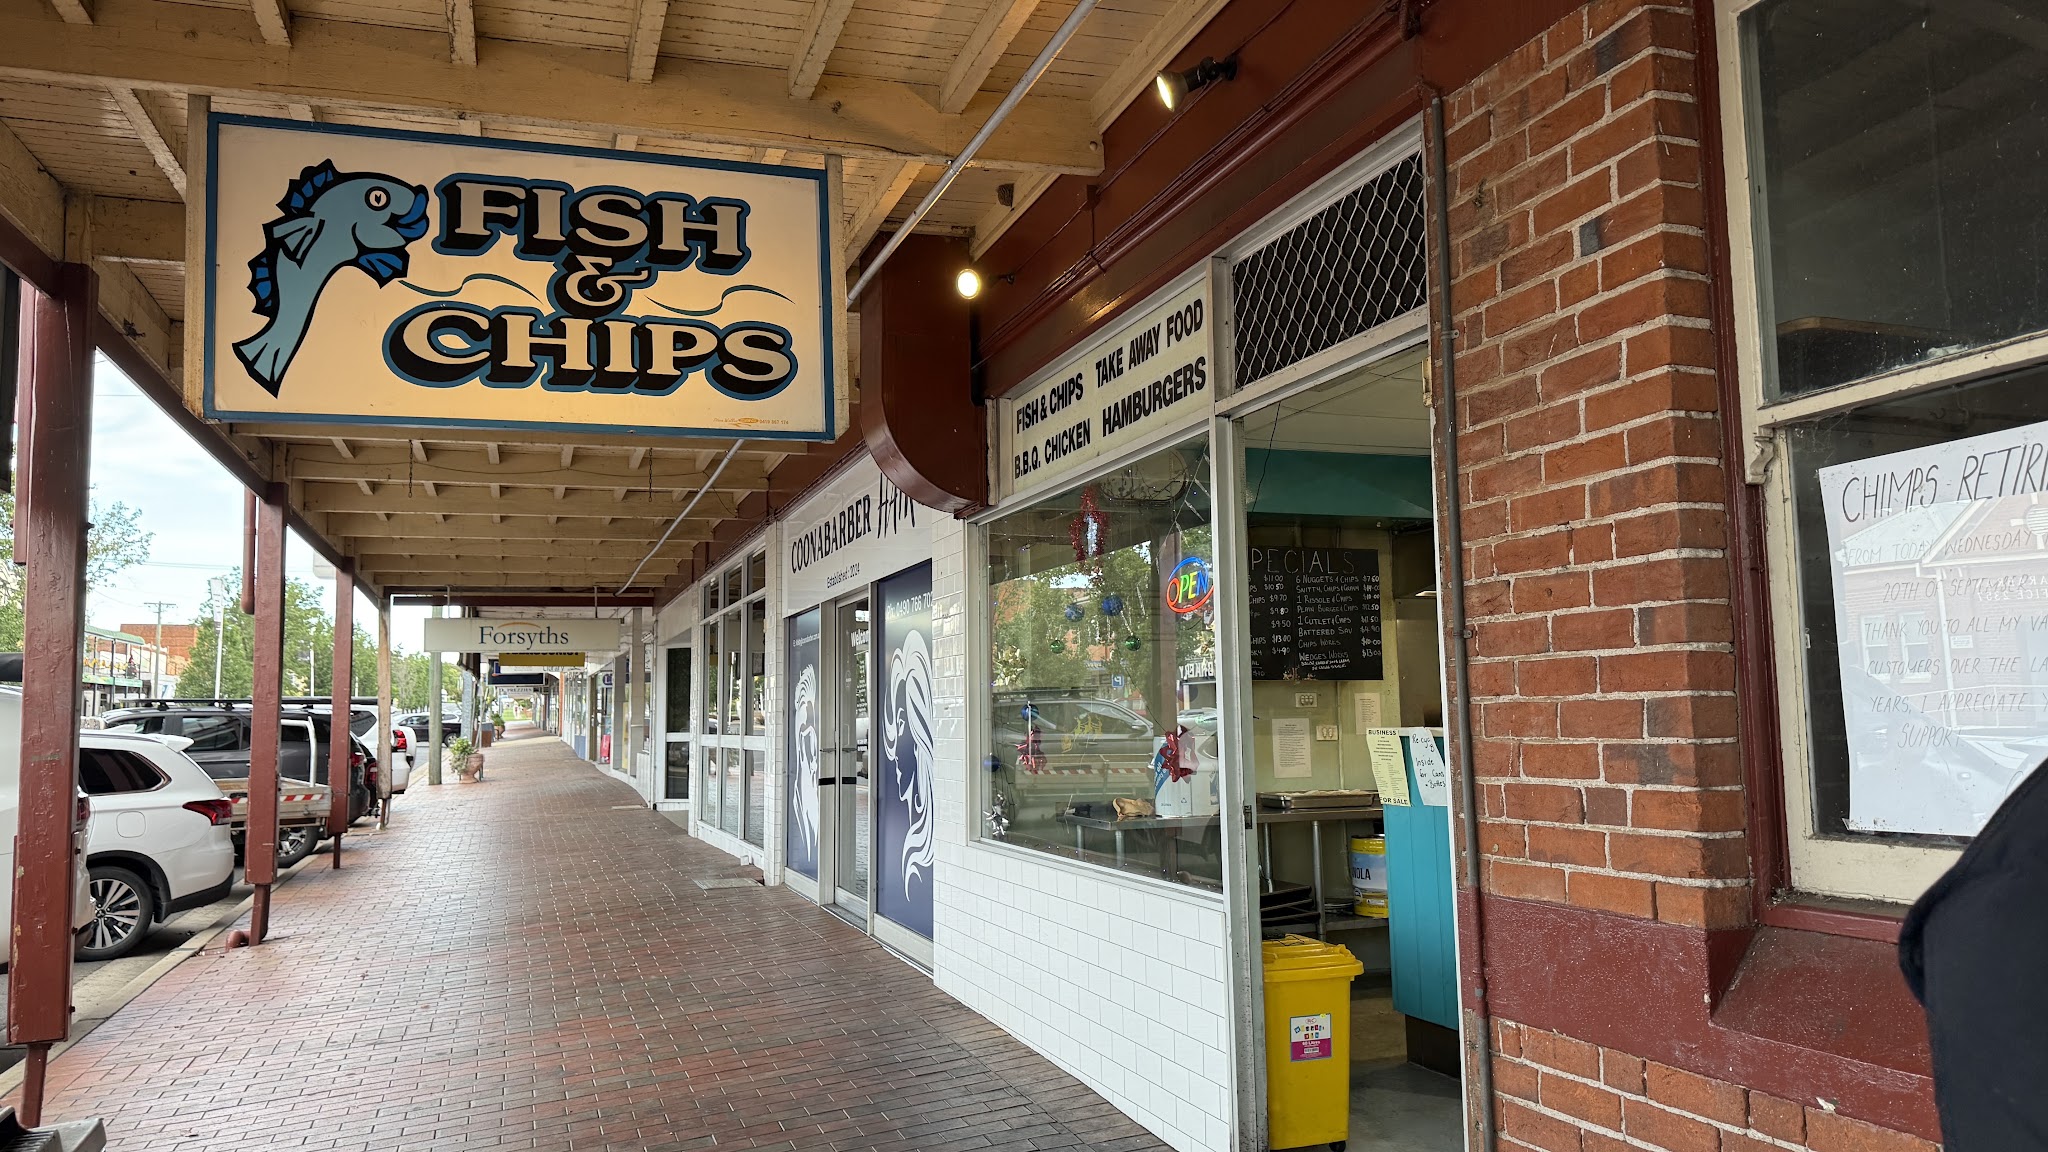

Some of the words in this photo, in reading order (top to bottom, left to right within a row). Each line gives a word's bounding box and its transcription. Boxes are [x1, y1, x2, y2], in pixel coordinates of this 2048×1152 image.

[438, 174, 750, 270] FISH
[554, 254, 650, 312] &
[386, 303, 797, 397] CHIPS
[1016, 400, 1039, 434] FISH
[1040, 394, 1048, 421] &
[1049, 372, 1083, 414] CHIPS
[1095, 346, 1124, 388] TAKE
[1128, 323, 1162, 370] AWAY
[1166, 298, 1204, 348] FOOD
[1014, 445, 1041, 479] B.B.Q.
[1044, 418, 1091, 464] CHICKEN
[1102, 356, 1206, 437] HAMBURGERS
[1842, 464, 1939, 523] CHIMPS
[791, 494, 871, 574] COONABARBER
[1846, 546, 1882, 566] FROM
[1892, 539, 1935, 561] TODAY
[1944, 528, 2033, 556] WEDNESDAY
[1167, 569, 1209, 607] OPEN
[1302, 574, 1333, 584] NUGGETS
[1340, 576, 1359, 584] CHIPS
[1324, 584, 1340, 592] CHIPS
[1882, 580, 1920, 604] 20TH
[1948, 573, 2029, 597] SEPTEMBER
[911, 595, 921, 612] 766
[1304, 594, 1330, 604] RISSOLE
[1336, 593, 1352, 602] CHIPS
[1298, 616, 1304, 625] 1
[1304, 616, 1332, 624] CUTLET
[1298, 628, 1336, 637] BATTERED
[1338, 626, 1352, 634] SAV
[1864, 622, 1908, 640] THANK
[1917, 619, 1940, 636] YOU
[1945, 618, 1960, 634] TO
[1966, 616, 1990, 633] ALL
[1999, 614, 2022, 633] MY
[2030, 614, 2048, 632] VA
[478, 625, 569, 650] Forsyths
[1250, 635, 1266, 644] HIPS
[1298, 640, 1318, 648] CHIPS
[1866, 658, 1941, 678] CUSTOMERS
[1950, 657, 1985, 675] OVER
[1989, 656, 2022, 673] THE
[2030, 656, 2048, 673] LA
[1869, 695, 1912, 715] YEARS,
[1920, 695, 1928, 714] I
[1937, 692, 2028, 713] APPRECIATE
[1897, 722, 1962, 748] SUPPORT
[1432, 768, 1444, 778] Cans
